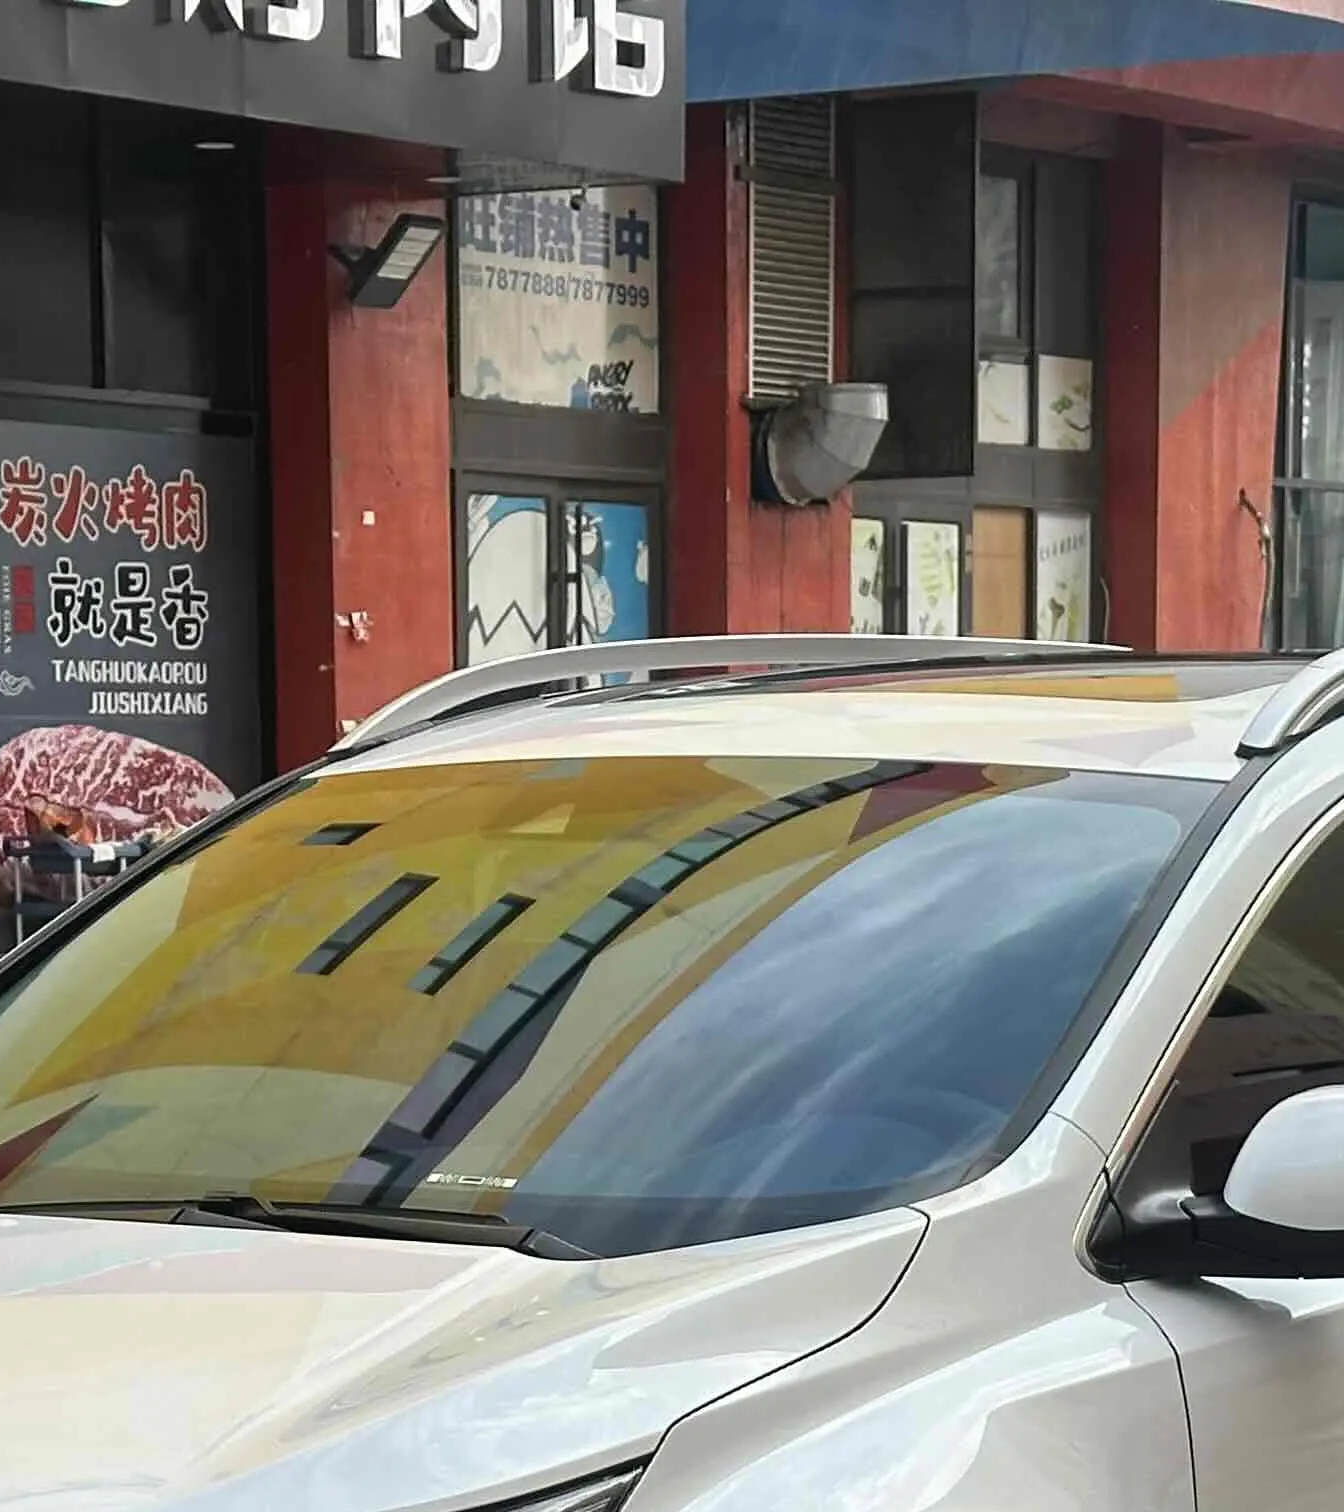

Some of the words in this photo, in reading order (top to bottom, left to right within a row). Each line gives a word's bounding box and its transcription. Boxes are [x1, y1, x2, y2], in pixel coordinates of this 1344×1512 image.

[47, 557, 209, 650] 就是香
[88, 692, 208, 715] JIUSHIXIANG
